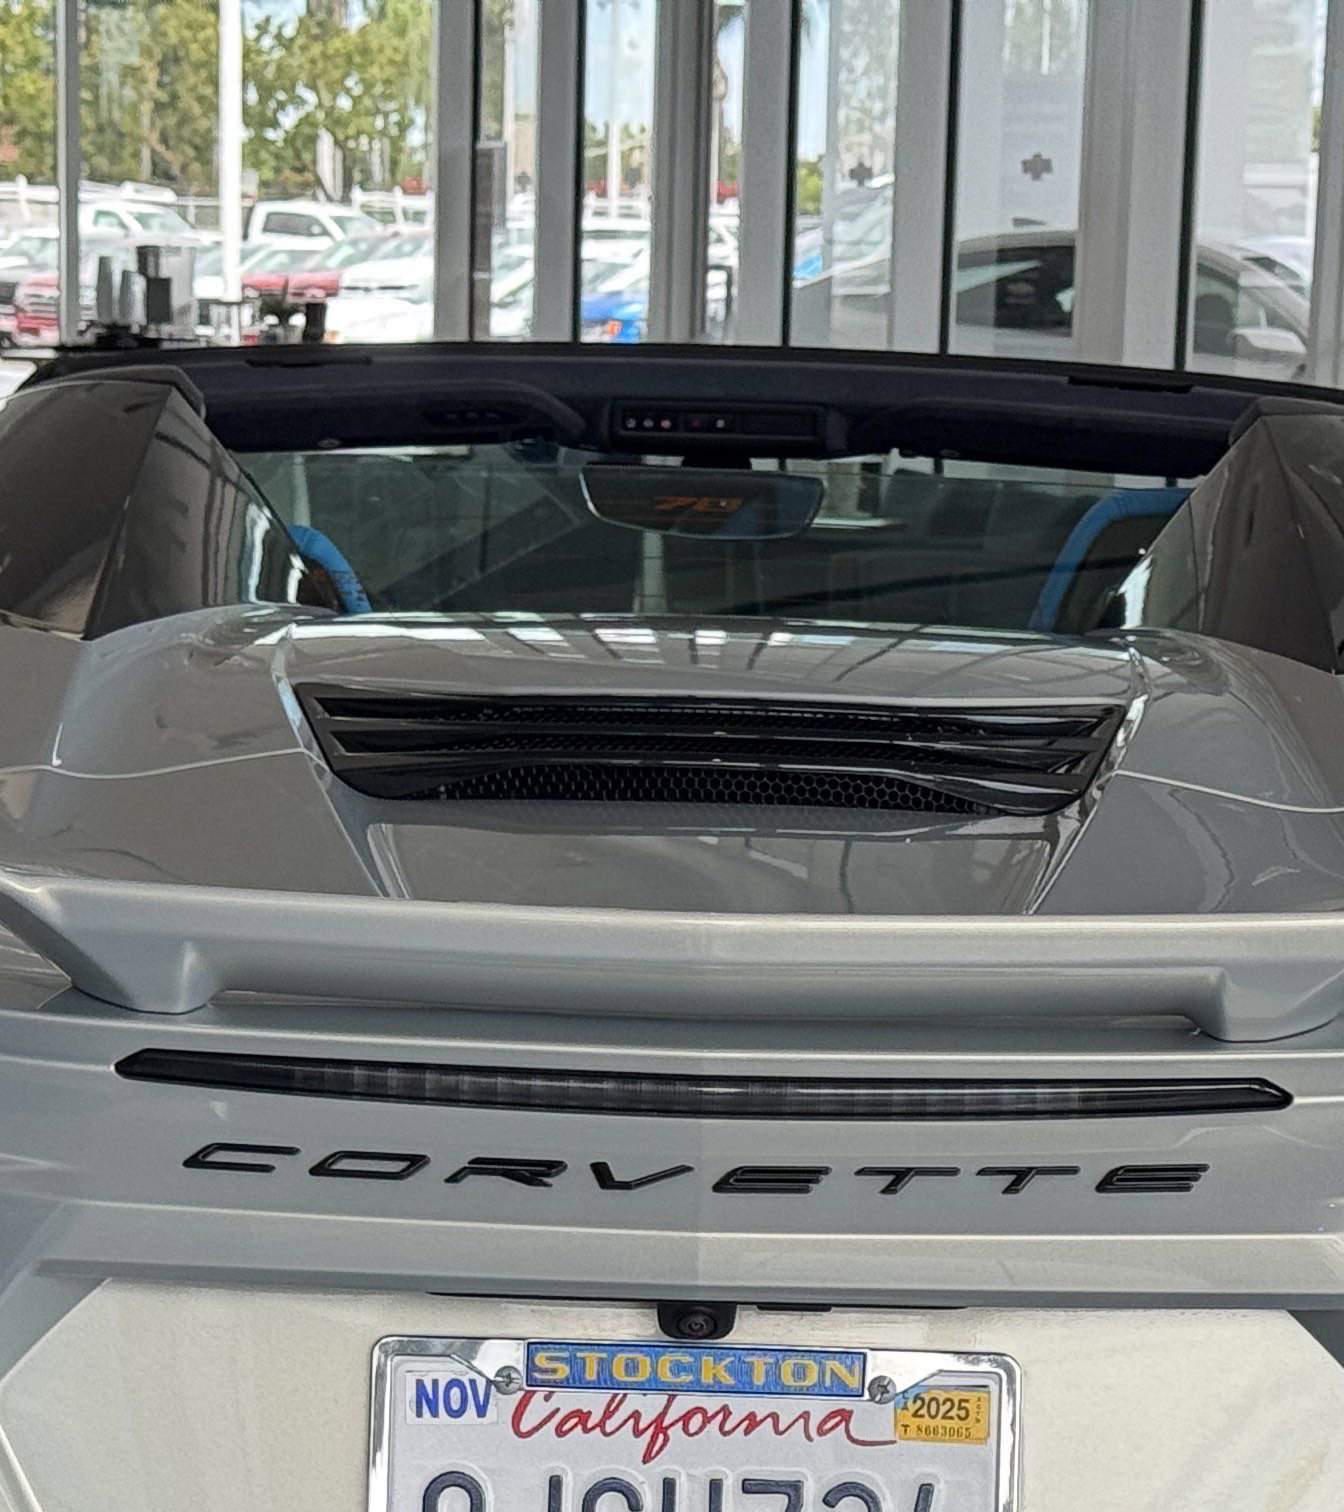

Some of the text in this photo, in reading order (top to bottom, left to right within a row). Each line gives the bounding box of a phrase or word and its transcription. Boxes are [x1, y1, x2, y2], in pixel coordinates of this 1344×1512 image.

[181, 1142, 1212, 1196] CORVETTE
[530, 1351, 861, 1389] STOCKTON
[414, 1377, 492, 1420] NOV
[911, 1395, 971, 1422] 2025
[509, 1390, 897, 1465] California
